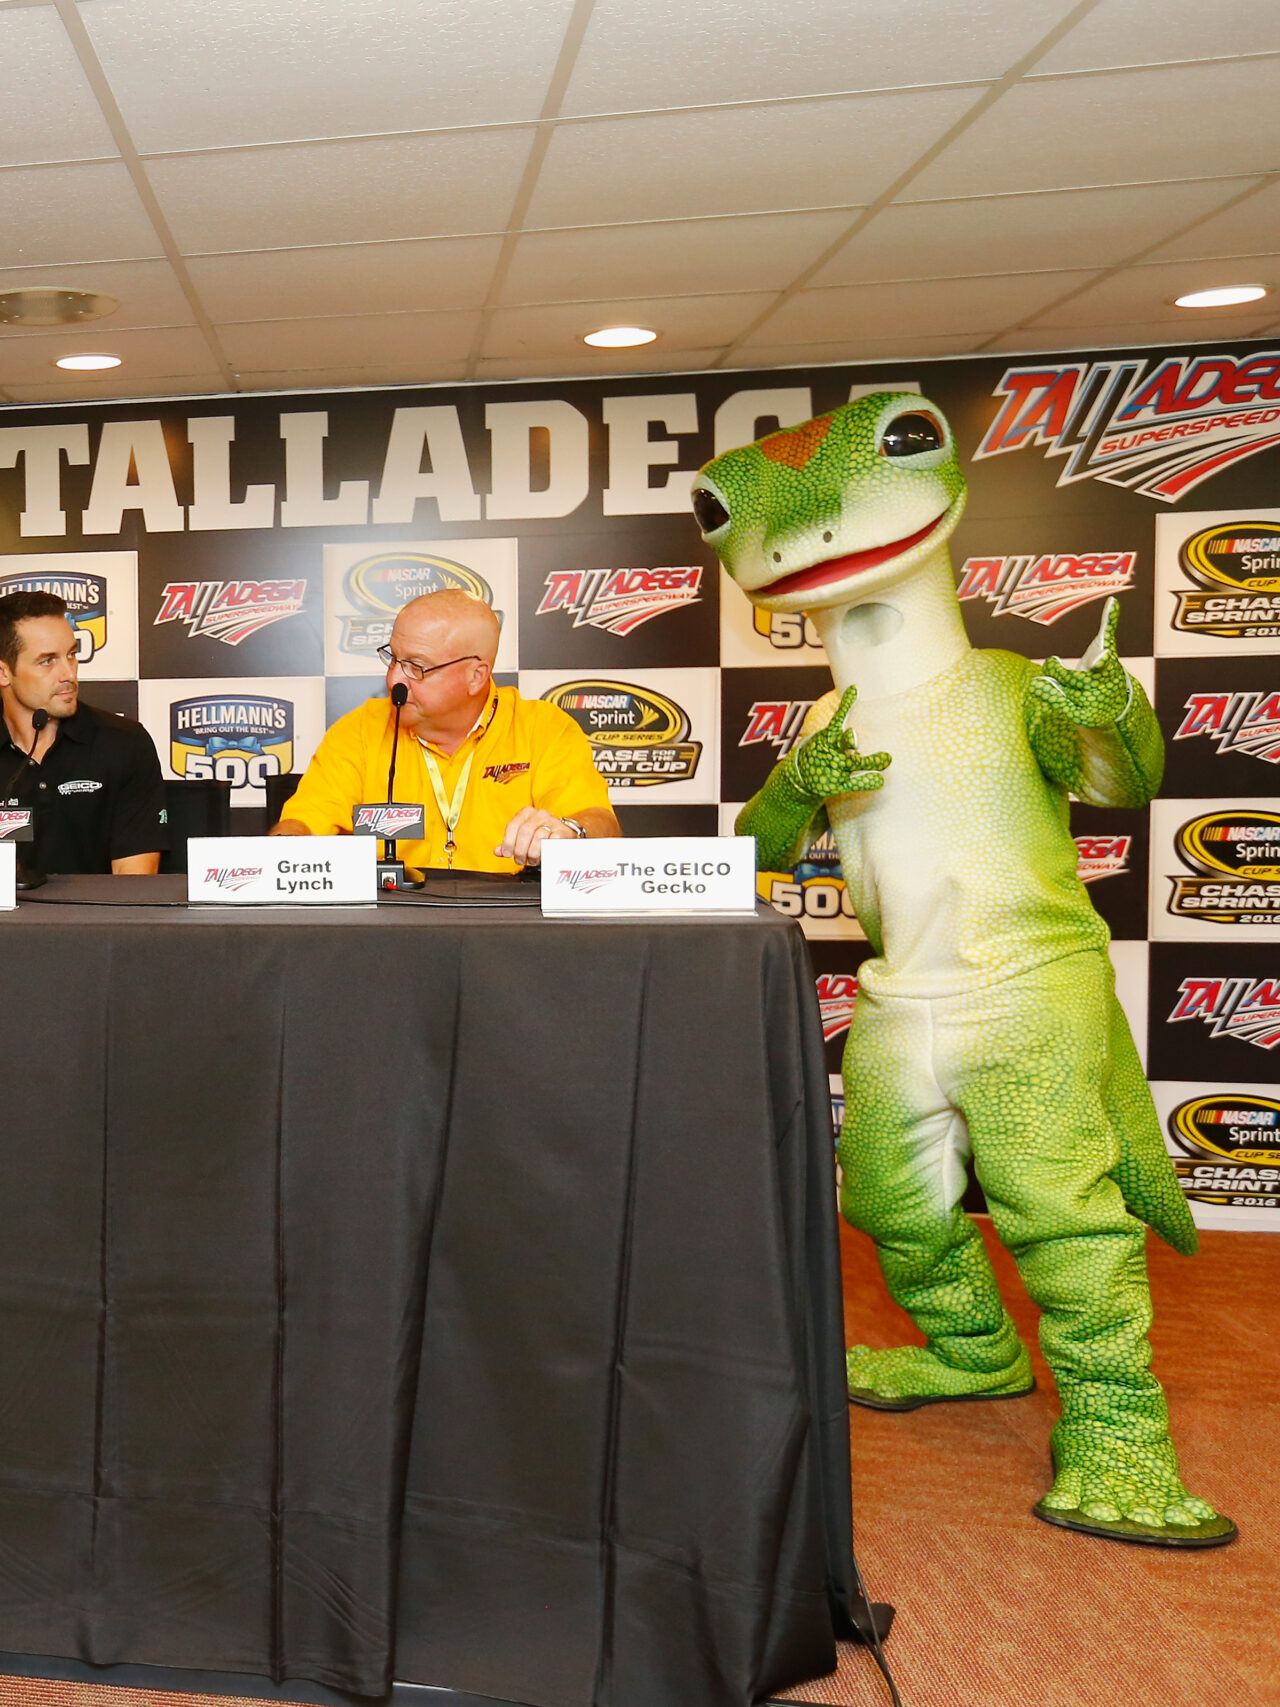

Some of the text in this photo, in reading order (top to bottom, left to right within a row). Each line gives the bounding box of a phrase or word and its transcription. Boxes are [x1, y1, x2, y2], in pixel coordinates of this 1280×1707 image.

[976, 354, 1280, 480] TALLADE
[1098, 408, 1280, 456] SUPERSPEED
[1241, 554, 1280, 573] Spri
[387, 567, 431, 582] NASCAR
[957, 552, 1135, 609] TALLADEGA
[1247, 579, 1277, 587] CUP
[395, 582, 438, 600] Sprint
[538, 567, 701, 623] TALLADEGA
[156, 580, 306, 633] TALLADEGA
[1204, 597, 1280, 610] CHAS
[1185, 609, 1280, 623] SPRIN
[1244, 627, 1280, 637] 201
[581, 694, 629, 709] NASCAR
[177, 703, 287, 730] HELLMANN'S
[589, 710, 635, 728] Sprint
[1176, 692, 1280, 749] TALLA
[595, 733, 664, 741] CUP SERIES
[592, 750, 649, 762] ASE
[185, 752, 280, 788] 500
[636, 761, 687, 773] CUP
[60, 782, 100, 790] GEICO
[607, 778, 632, 786] 016
[357, 809, 421, 829] TALLADEGA
[809, 852, 825, 860] OUT
[1236, 843, 1280, 862] Sprin
[277, 860, 332, 874] Grant
[616, 862, 731, 877] The GEICO
[1242, 867, 1272, 875] CUP
[204, 867, 263, 887] TALLADEGA
[556, 869, 618, 889] TALLADEGA
[276, 877, 334, 894] Lynch
[641, 880, 707, 894] Gecko
[1200, 884, 1280, 897] CHAS
[1170, 978, 1280, 1033] TALLA
[1220, 1110, 1275, 1126] NASCAR
[1229, 1126, 1280, 1145] Sprint
[1235, 1150, 1265, 1159] CUP
[1193, 1166, 1280, 1181] CHAS
[1178, 1178, 1279, 1192] SPRINT
[1231, 1196, 1277, 1207] 2016
